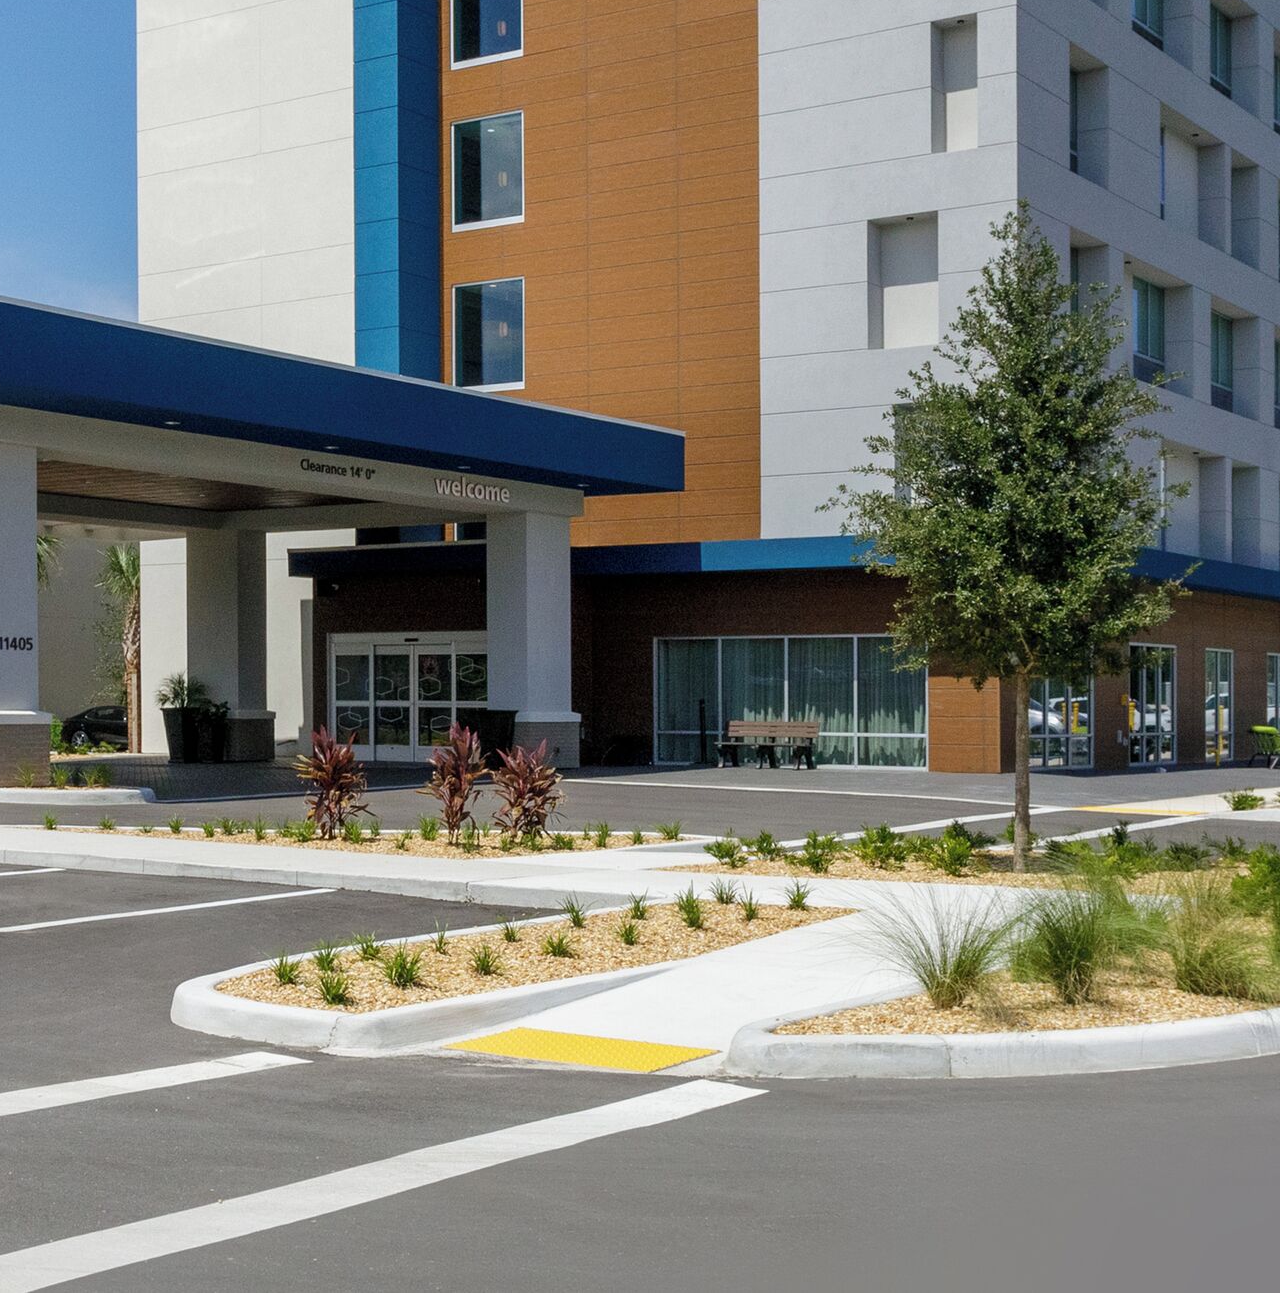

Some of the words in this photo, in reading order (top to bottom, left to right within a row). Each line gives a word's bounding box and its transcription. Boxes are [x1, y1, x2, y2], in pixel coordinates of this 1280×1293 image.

[300, 458, 347, 476] Clearance
[350, 466, 363, 478] 14'
[434, 476, 510, 503] welcome
